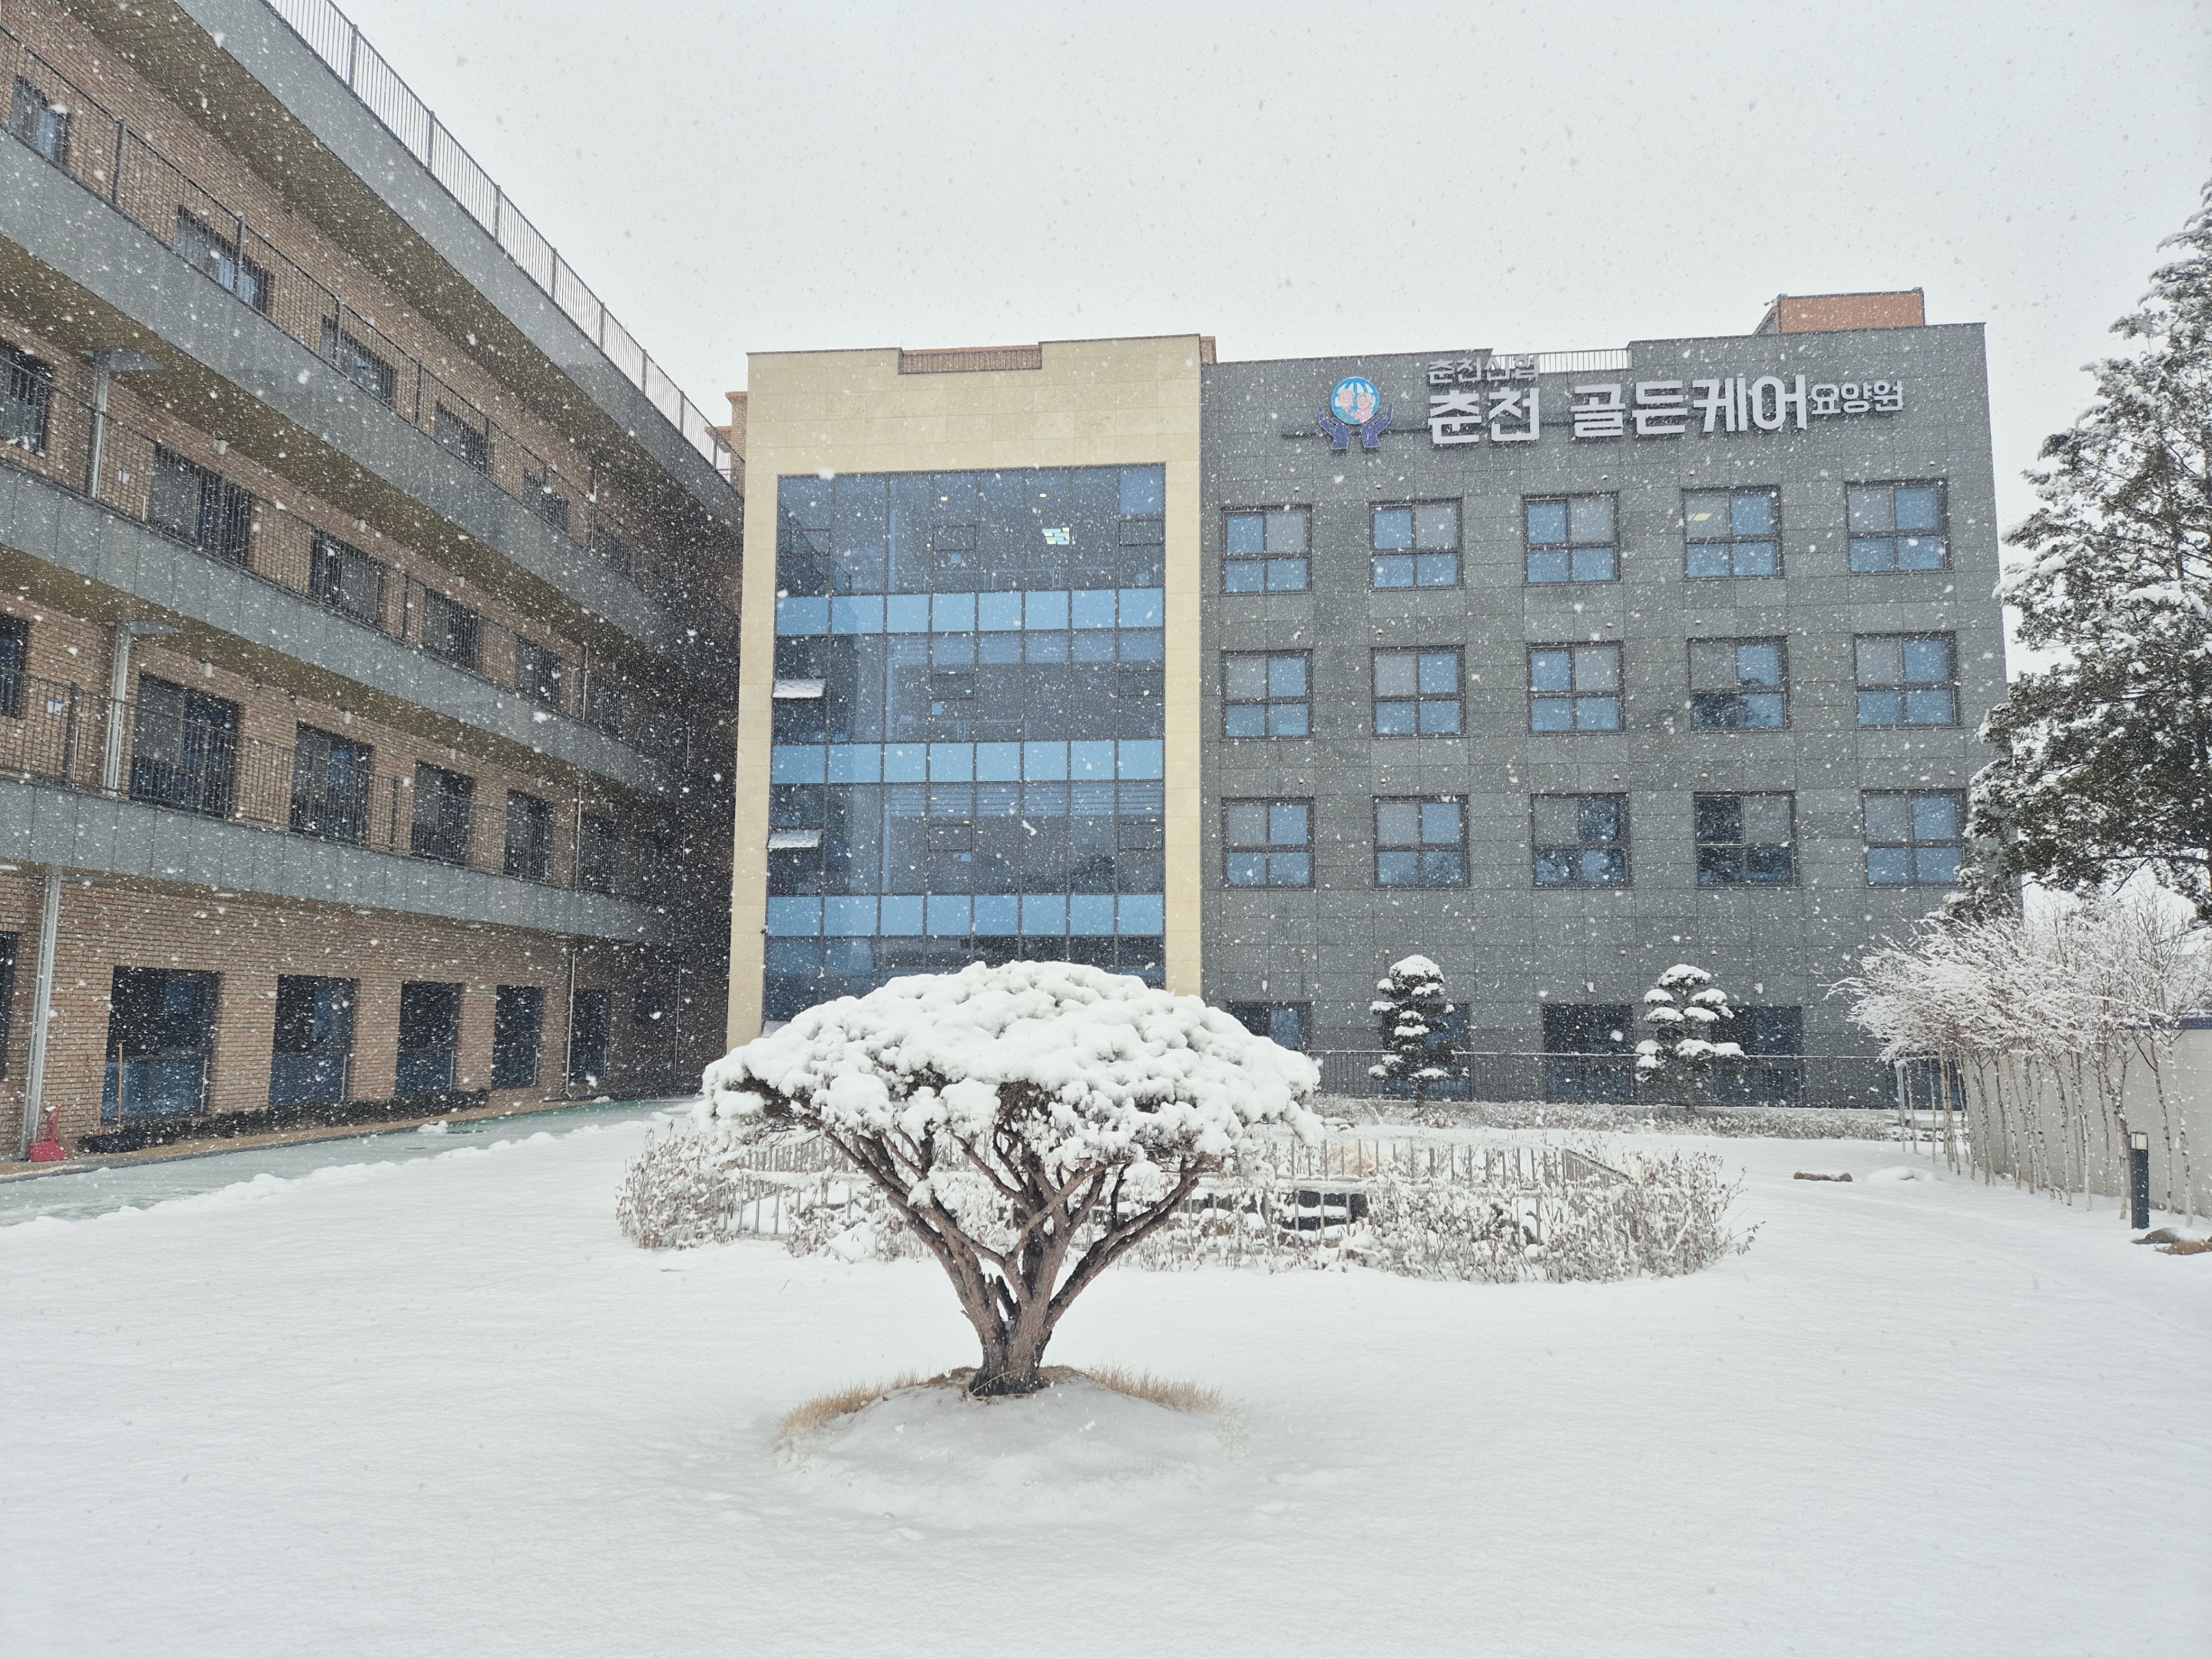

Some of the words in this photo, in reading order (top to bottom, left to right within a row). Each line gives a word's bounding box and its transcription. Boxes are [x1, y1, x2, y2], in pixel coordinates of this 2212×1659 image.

[1428, 354, 1538, 383] 춘천신협
[1428, 386, 1540, 444] 춘천
[1571, 375, 1807, 438] 골든케어
[1811, 379, 1903, 415] 요양원
